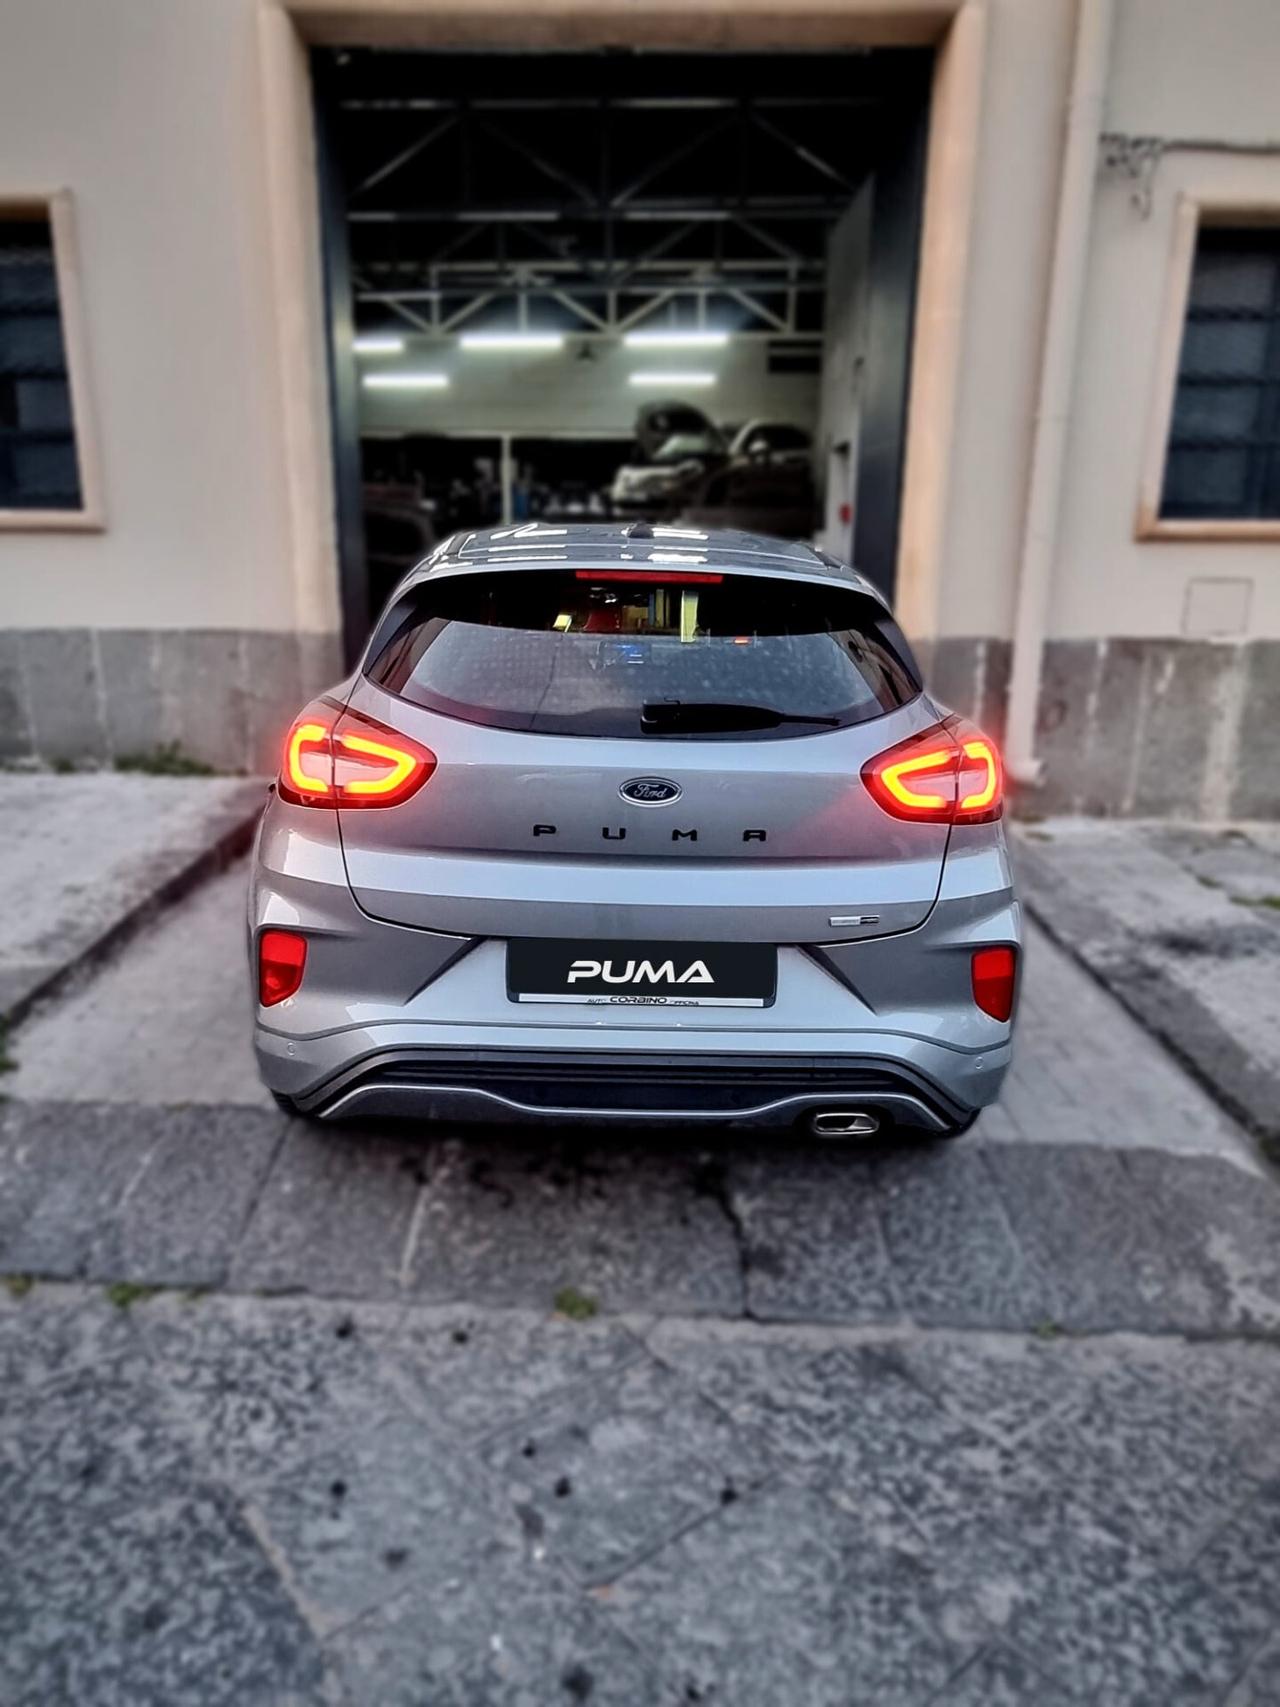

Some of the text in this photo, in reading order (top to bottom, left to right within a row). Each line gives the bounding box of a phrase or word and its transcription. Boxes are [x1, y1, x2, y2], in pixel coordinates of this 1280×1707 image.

[633, 783, 668, 798] Ford
[533, 824, 767, 842] PUMA
[609, 995, 668, 1004] CORBINO
